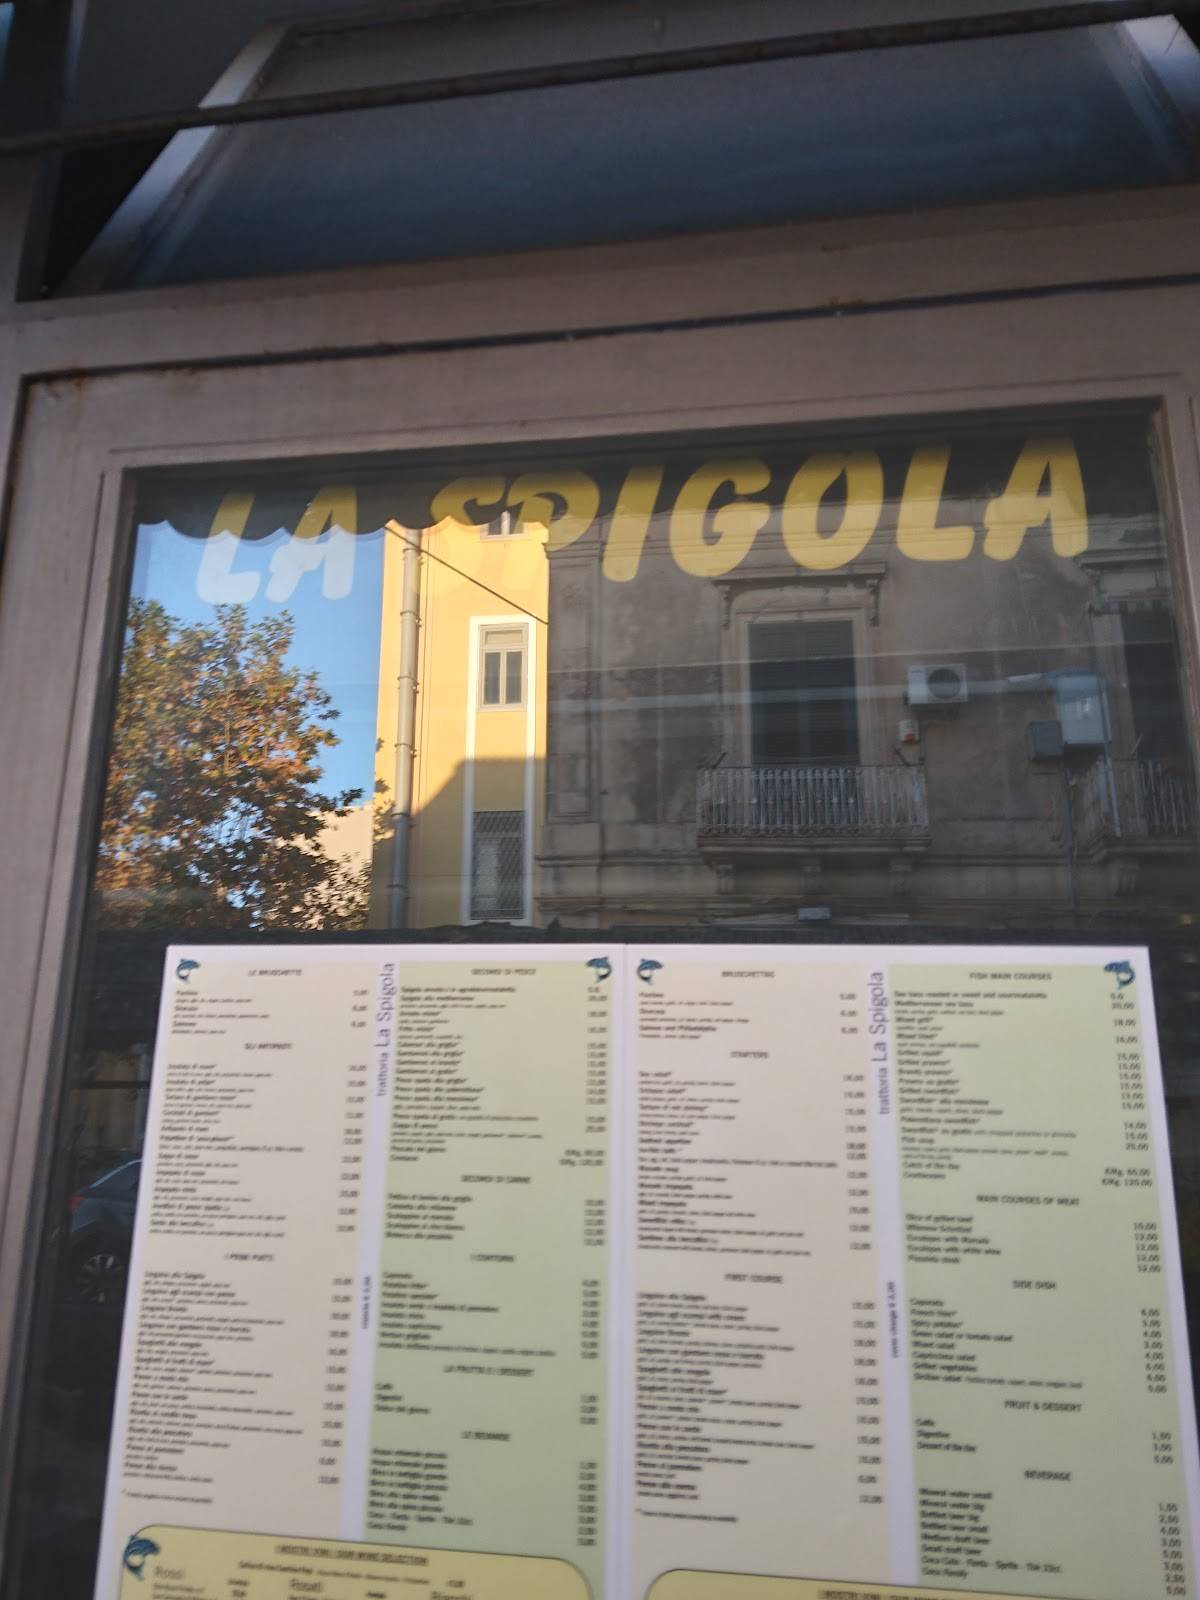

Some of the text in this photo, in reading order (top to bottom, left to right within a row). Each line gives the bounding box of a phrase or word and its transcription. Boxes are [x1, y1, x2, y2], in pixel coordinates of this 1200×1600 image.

[196, 437, 1090, 603] LA SPIGOLA
[374, 963, 397, 1096] trattoria La Spigola
[867, 972, 890, 1115] trattoria La Spigola
